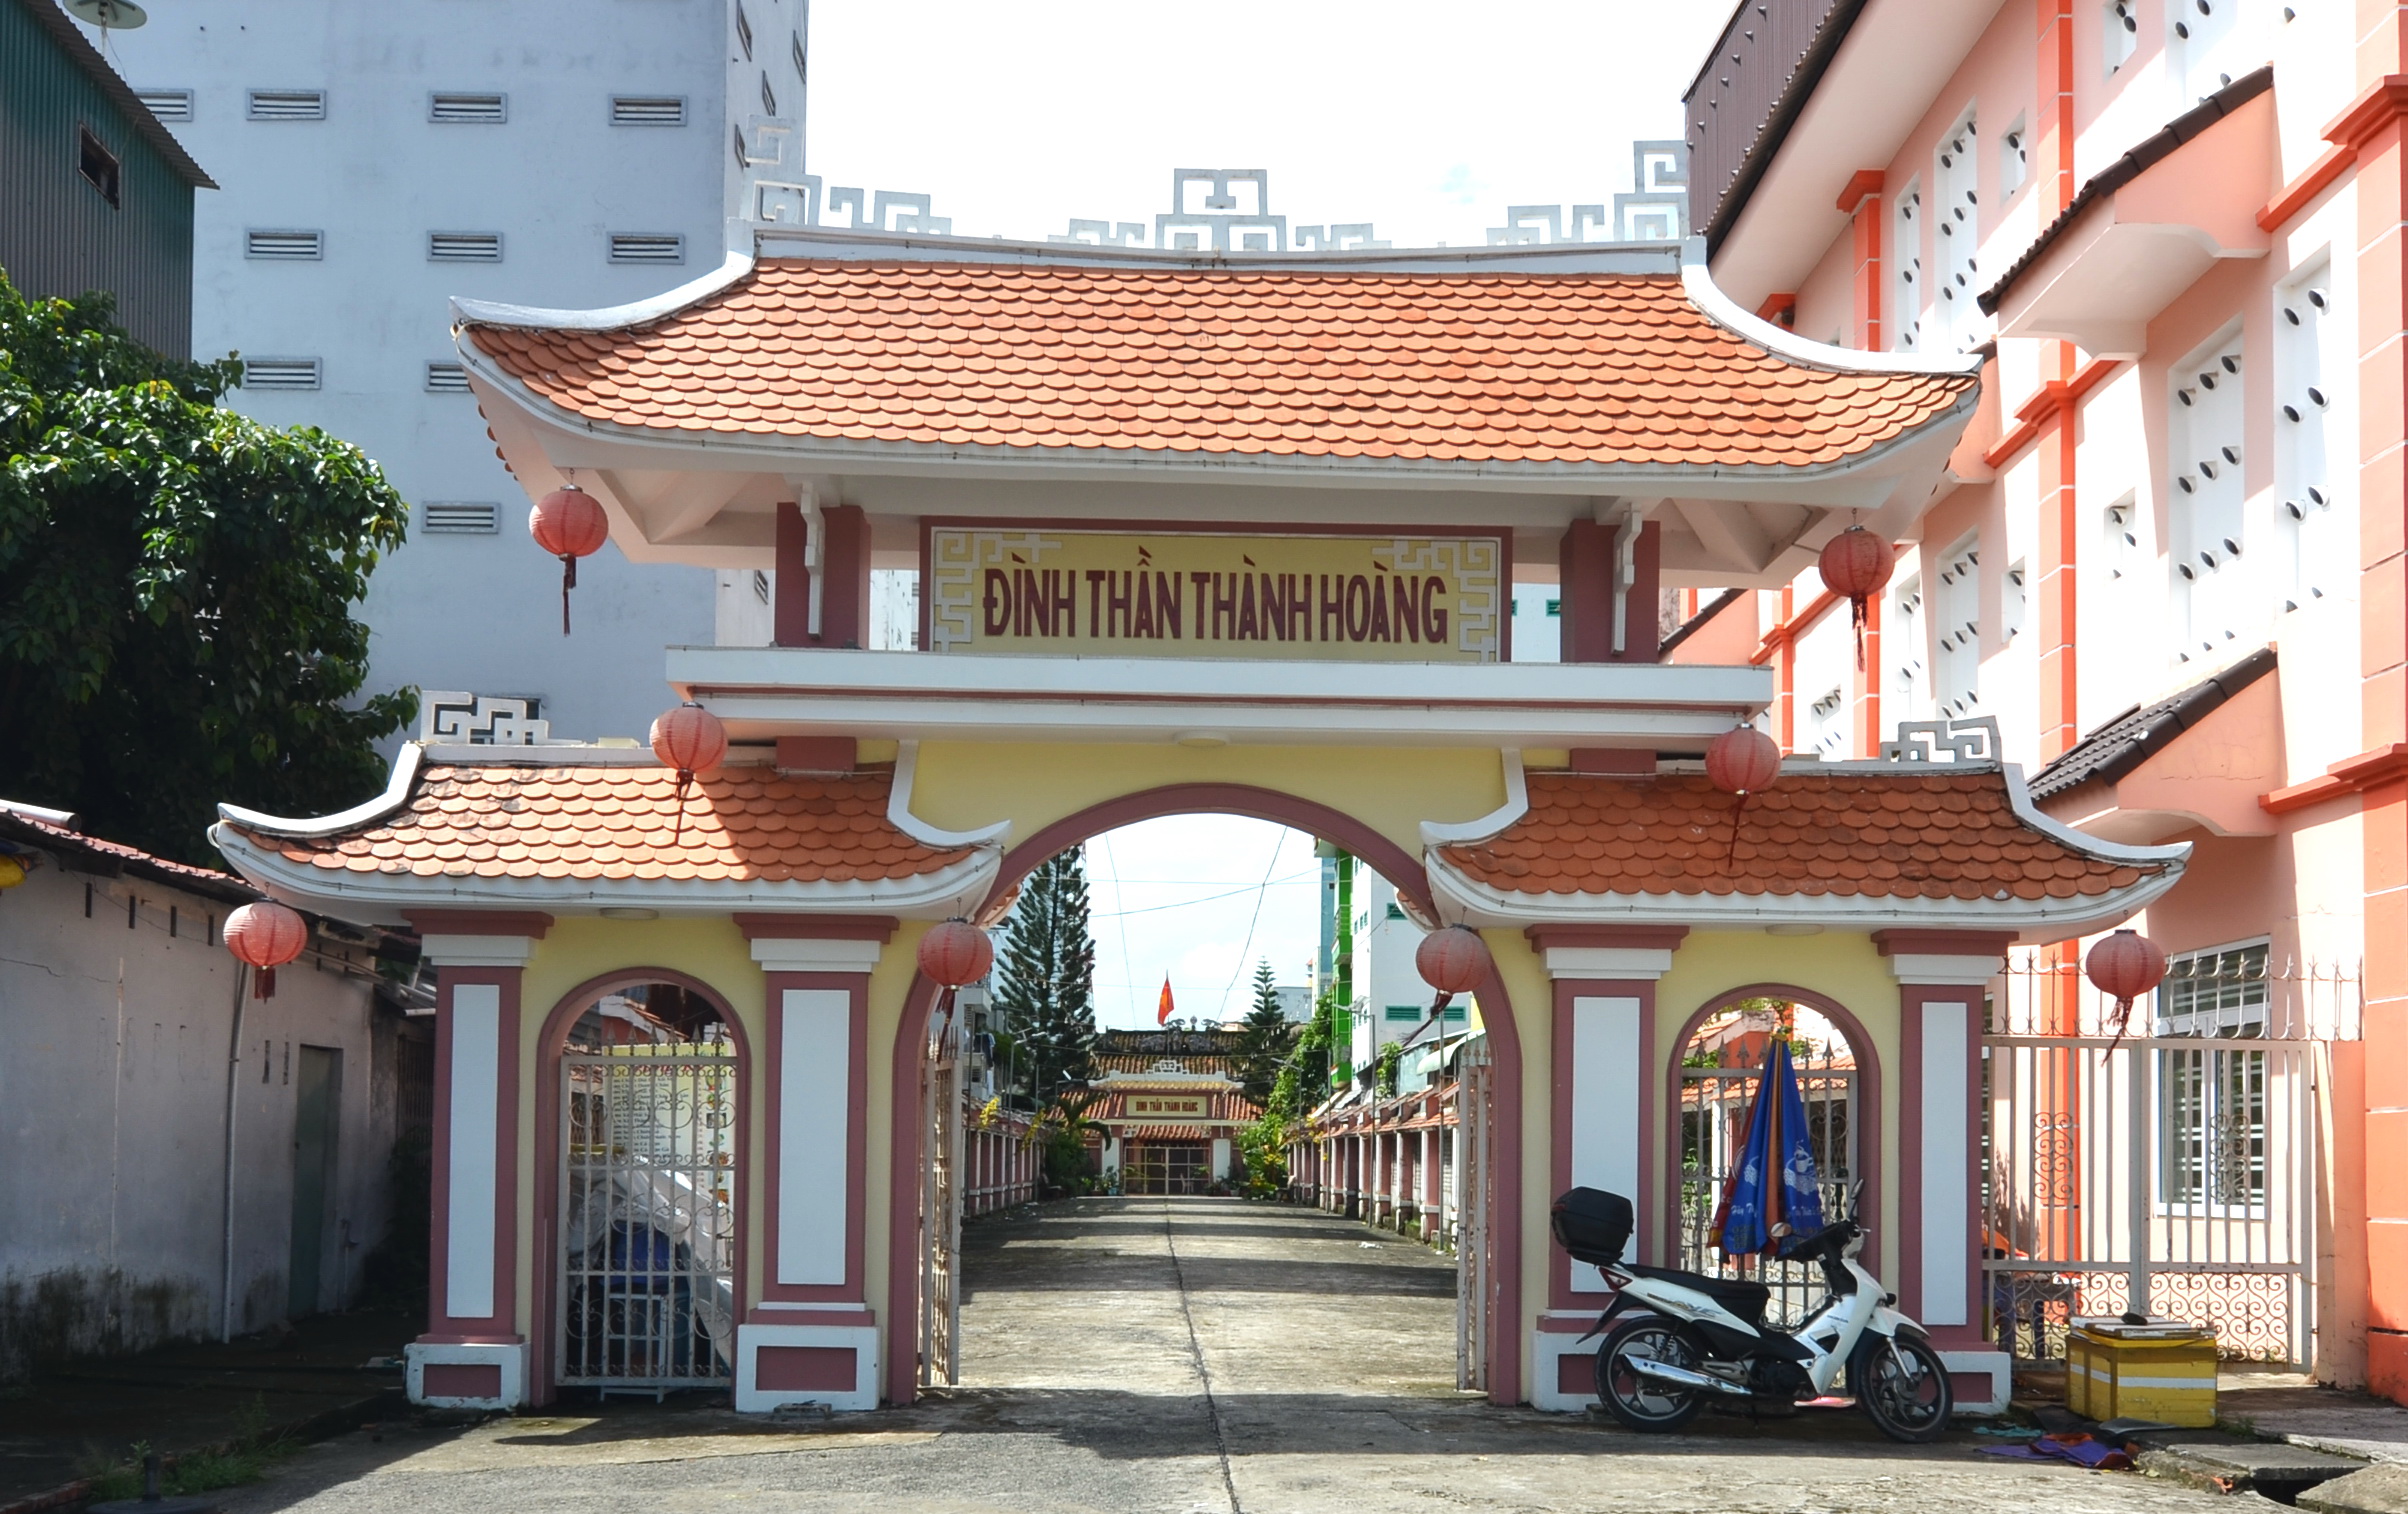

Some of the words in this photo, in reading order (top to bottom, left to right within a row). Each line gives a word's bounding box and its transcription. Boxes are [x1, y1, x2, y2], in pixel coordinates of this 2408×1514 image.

[982, 551, 1077, 637] ĐÌNH
[1085, 545, 1182, 640] THẦN
[1190, 554, 1312, 642] THÀNH
[1319, 560, 1449, 644] HOÀNG
